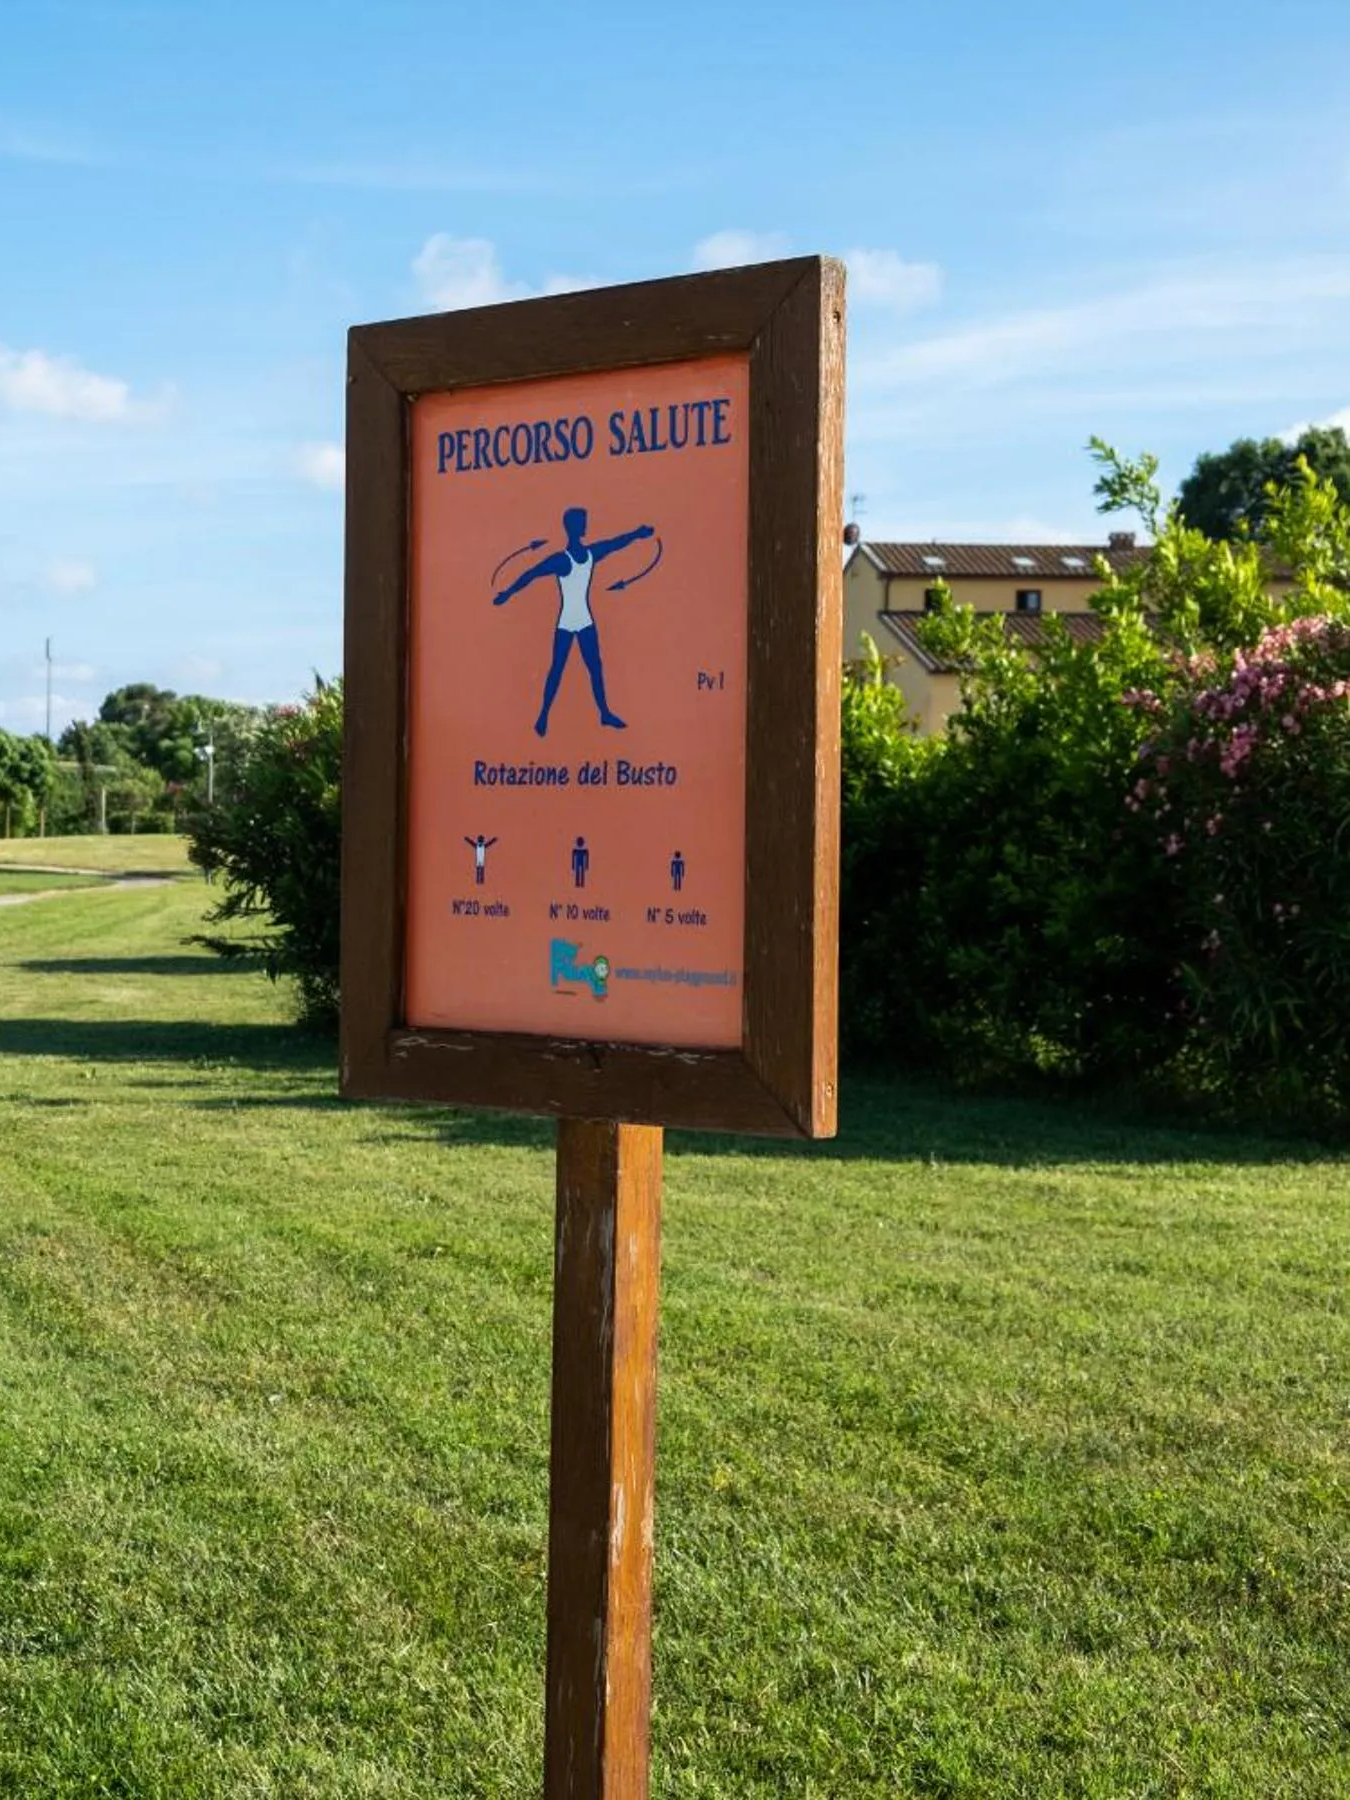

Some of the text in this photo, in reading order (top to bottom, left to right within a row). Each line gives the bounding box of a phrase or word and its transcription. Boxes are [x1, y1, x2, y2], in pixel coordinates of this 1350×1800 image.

[437, 399, 732, 474] PERCORSO SALUTE
[473, 760, 679, 786] Rotazione del Busto
[483, 901, 511, 918] volte
[582, 905, 611, 922] volte
[665, 907, 675, 925] 5
[677, 908, 708, 926] volte
